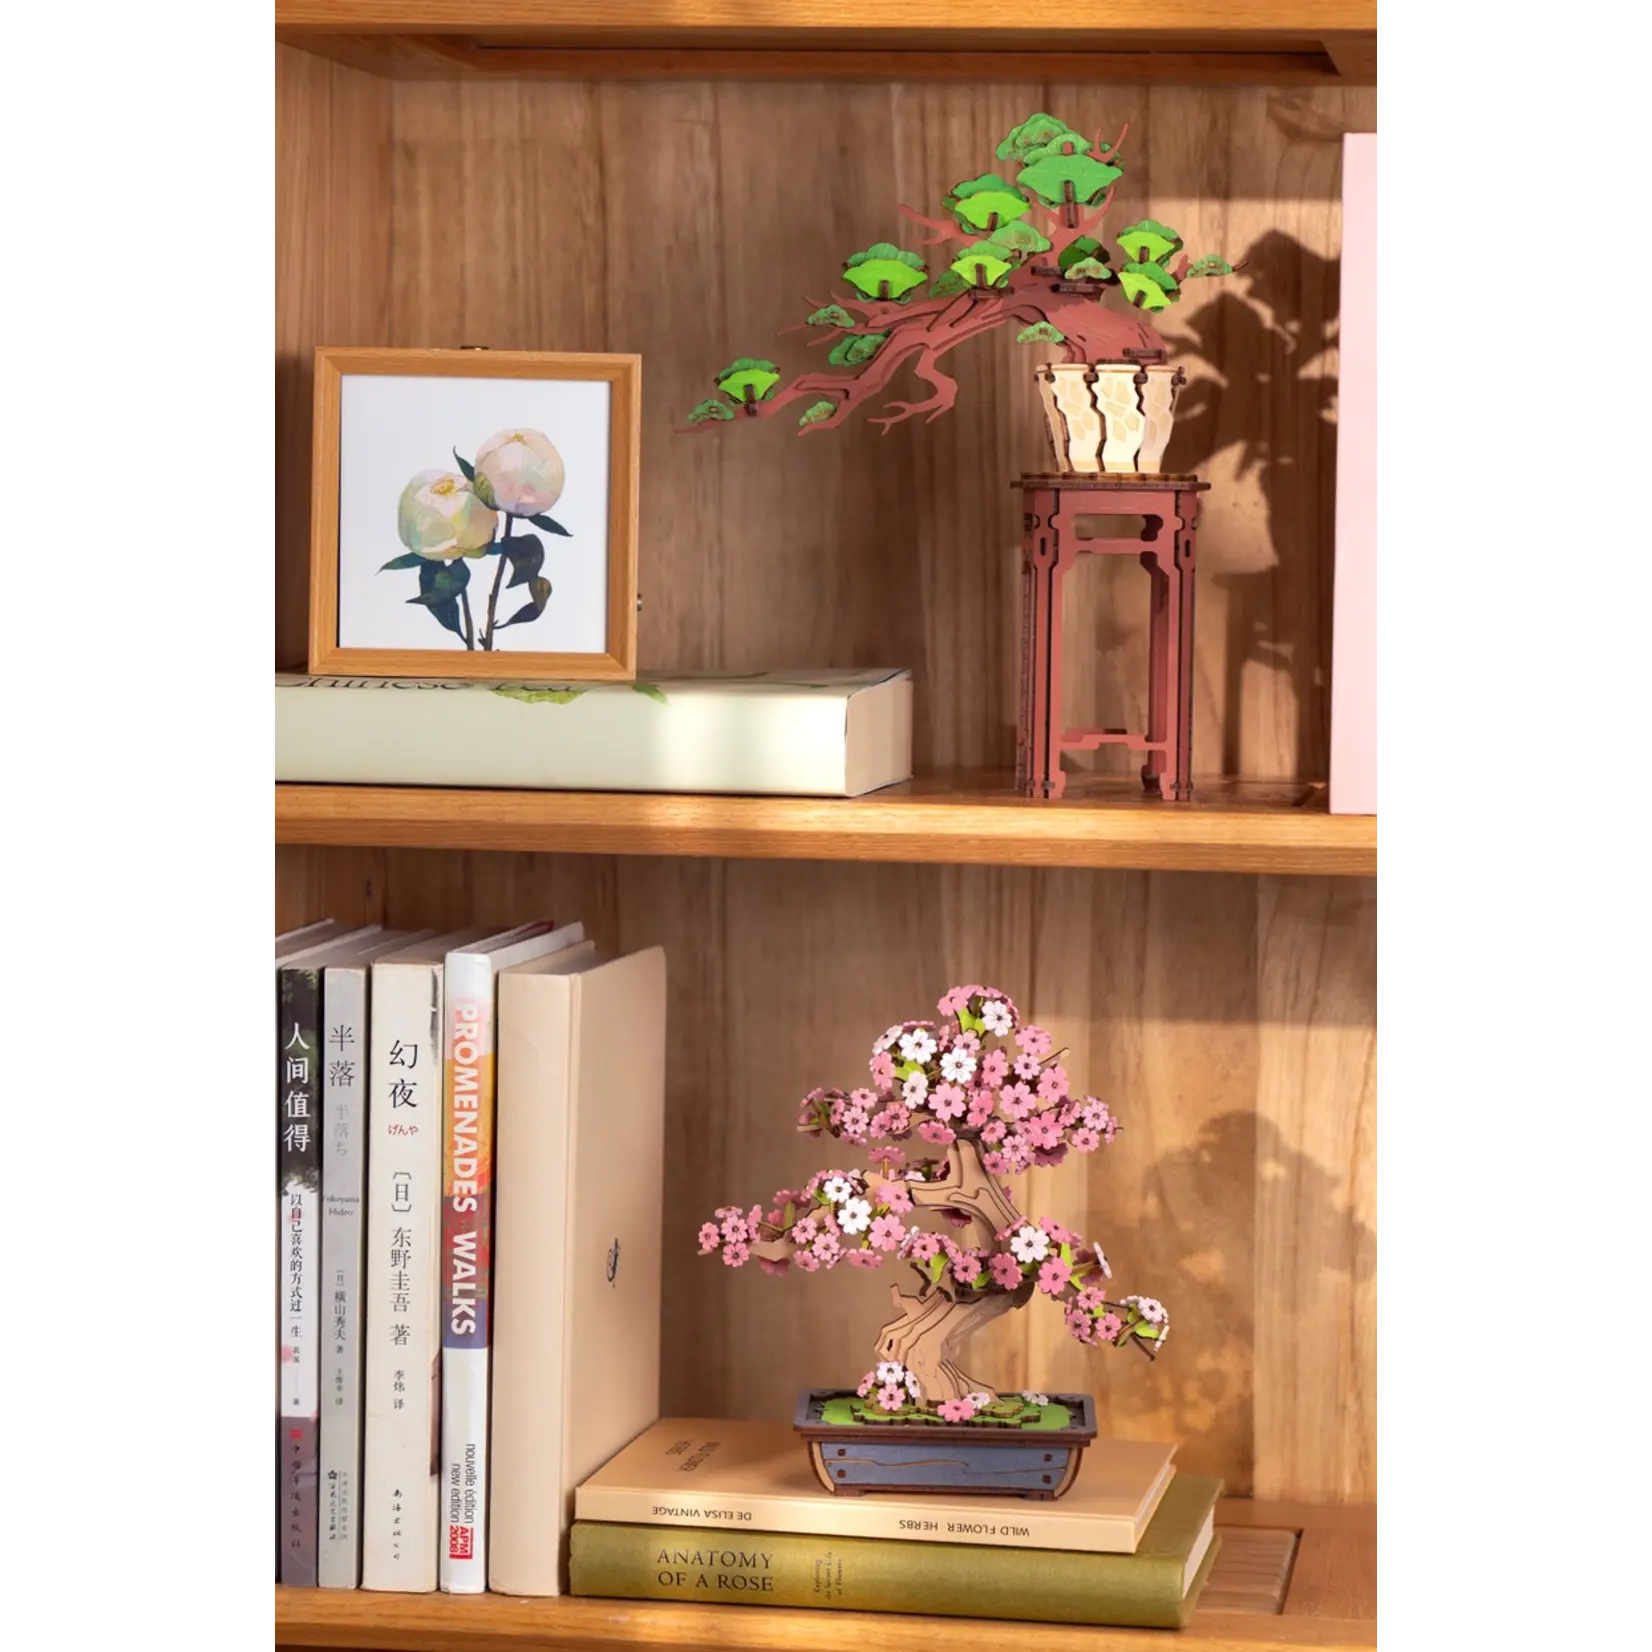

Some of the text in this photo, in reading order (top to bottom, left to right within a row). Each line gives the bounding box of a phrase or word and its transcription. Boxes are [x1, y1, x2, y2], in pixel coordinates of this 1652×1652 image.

[329, 1024, 356, 1087] 半落
[388, 1039, 418, 1109] 幻夜
[284, 1022, 311, 1152] 人间值得
[388, 1124, 419, 1136] げんや
[451, 1004, 479, 1335] PROMENADES WALKS
[289, 1193, 303, 1338] 以自己喜欢的方式过一生
[390, 1227, 412, 1313] 东野圭吾
[390, 1324, 411, 1345] 著
[393, 1398, 404, 1410] 译
[450, 1463, 462, 1523] new edition
[464, 1443, 477, 1524] nouvelle édition
[652, 1505, 752, 1521] DE ELISA VINTAGE
[898, 1519, 1030, 1537] WILD FLOWER HERBS
[460, 1526, 469, 1553] APM
[657, 1548, 774, 1569] ANATOMY
[658, 1571, 775, 1592] OF A ROSE
